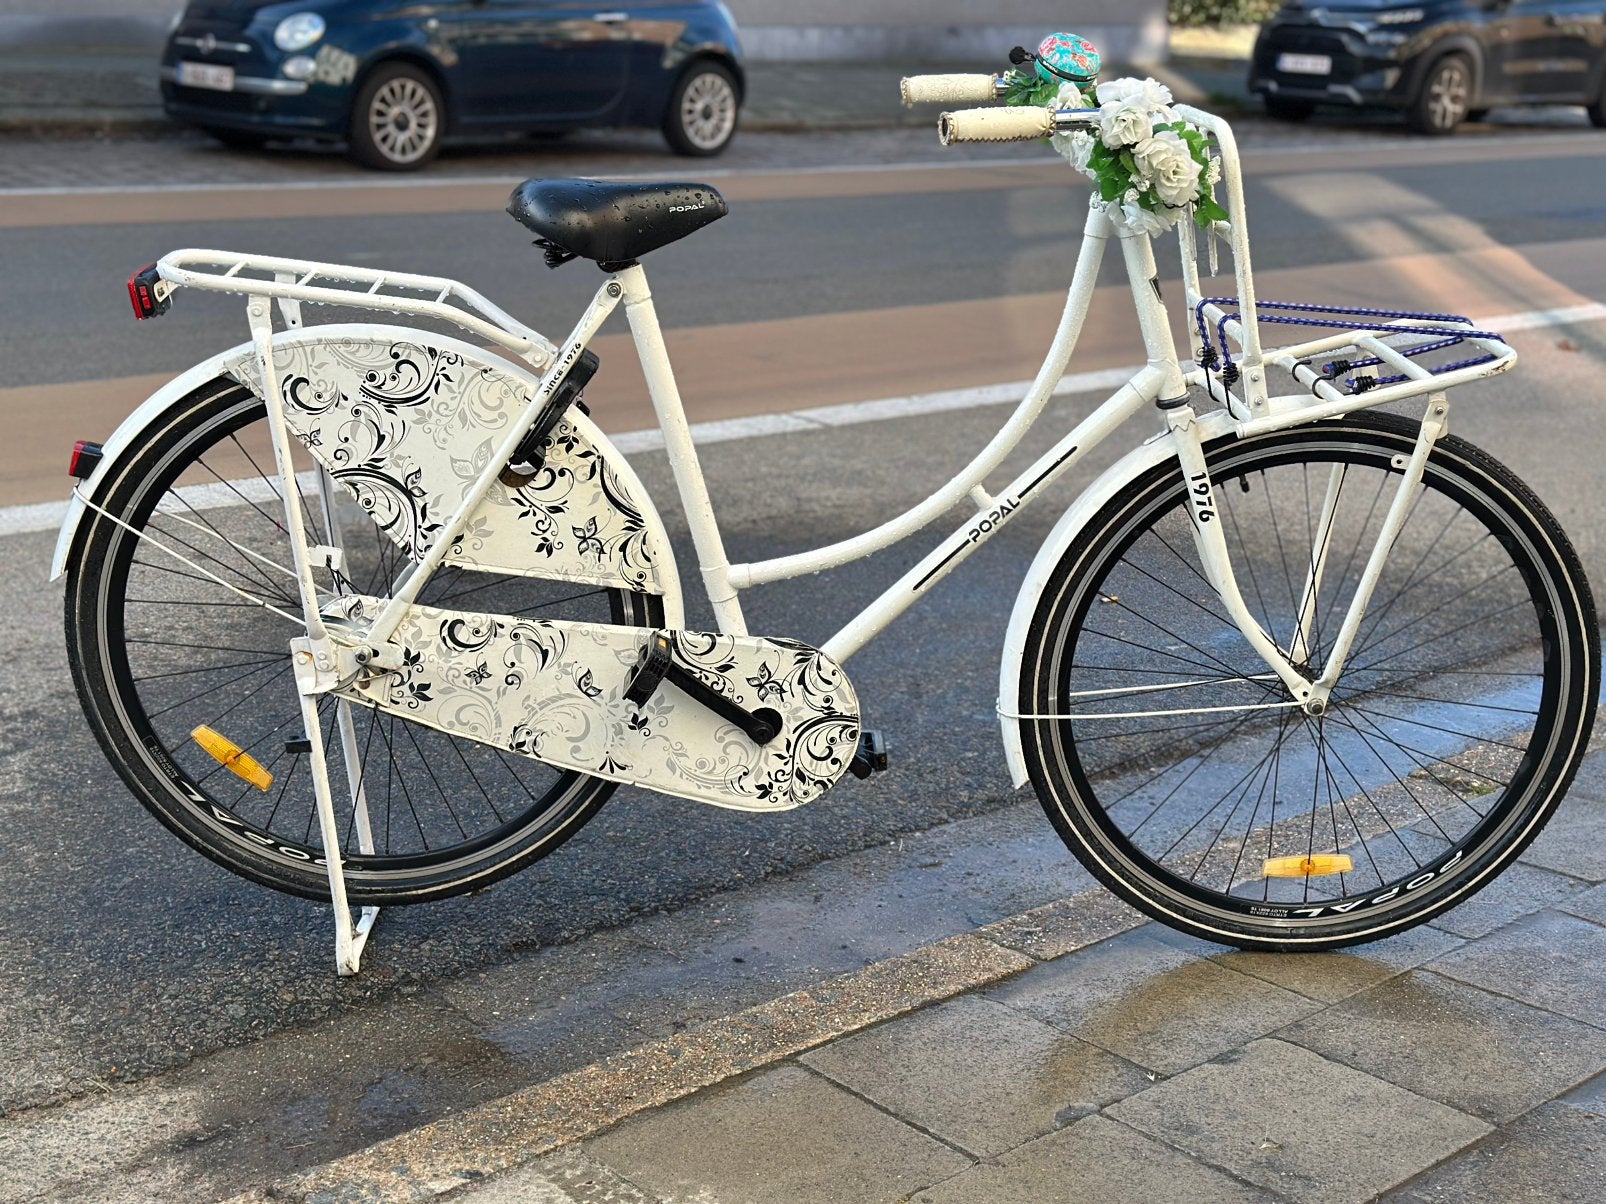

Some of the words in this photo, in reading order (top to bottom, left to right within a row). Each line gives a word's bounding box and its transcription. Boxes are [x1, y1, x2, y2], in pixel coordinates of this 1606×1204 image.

[669, 202, 705, 213] POPAL
[968, 498, 1021, 543] POPAL
[1190, 471, 1216, 523] 1976
[1293, 850, 1463, 918] POPAL
